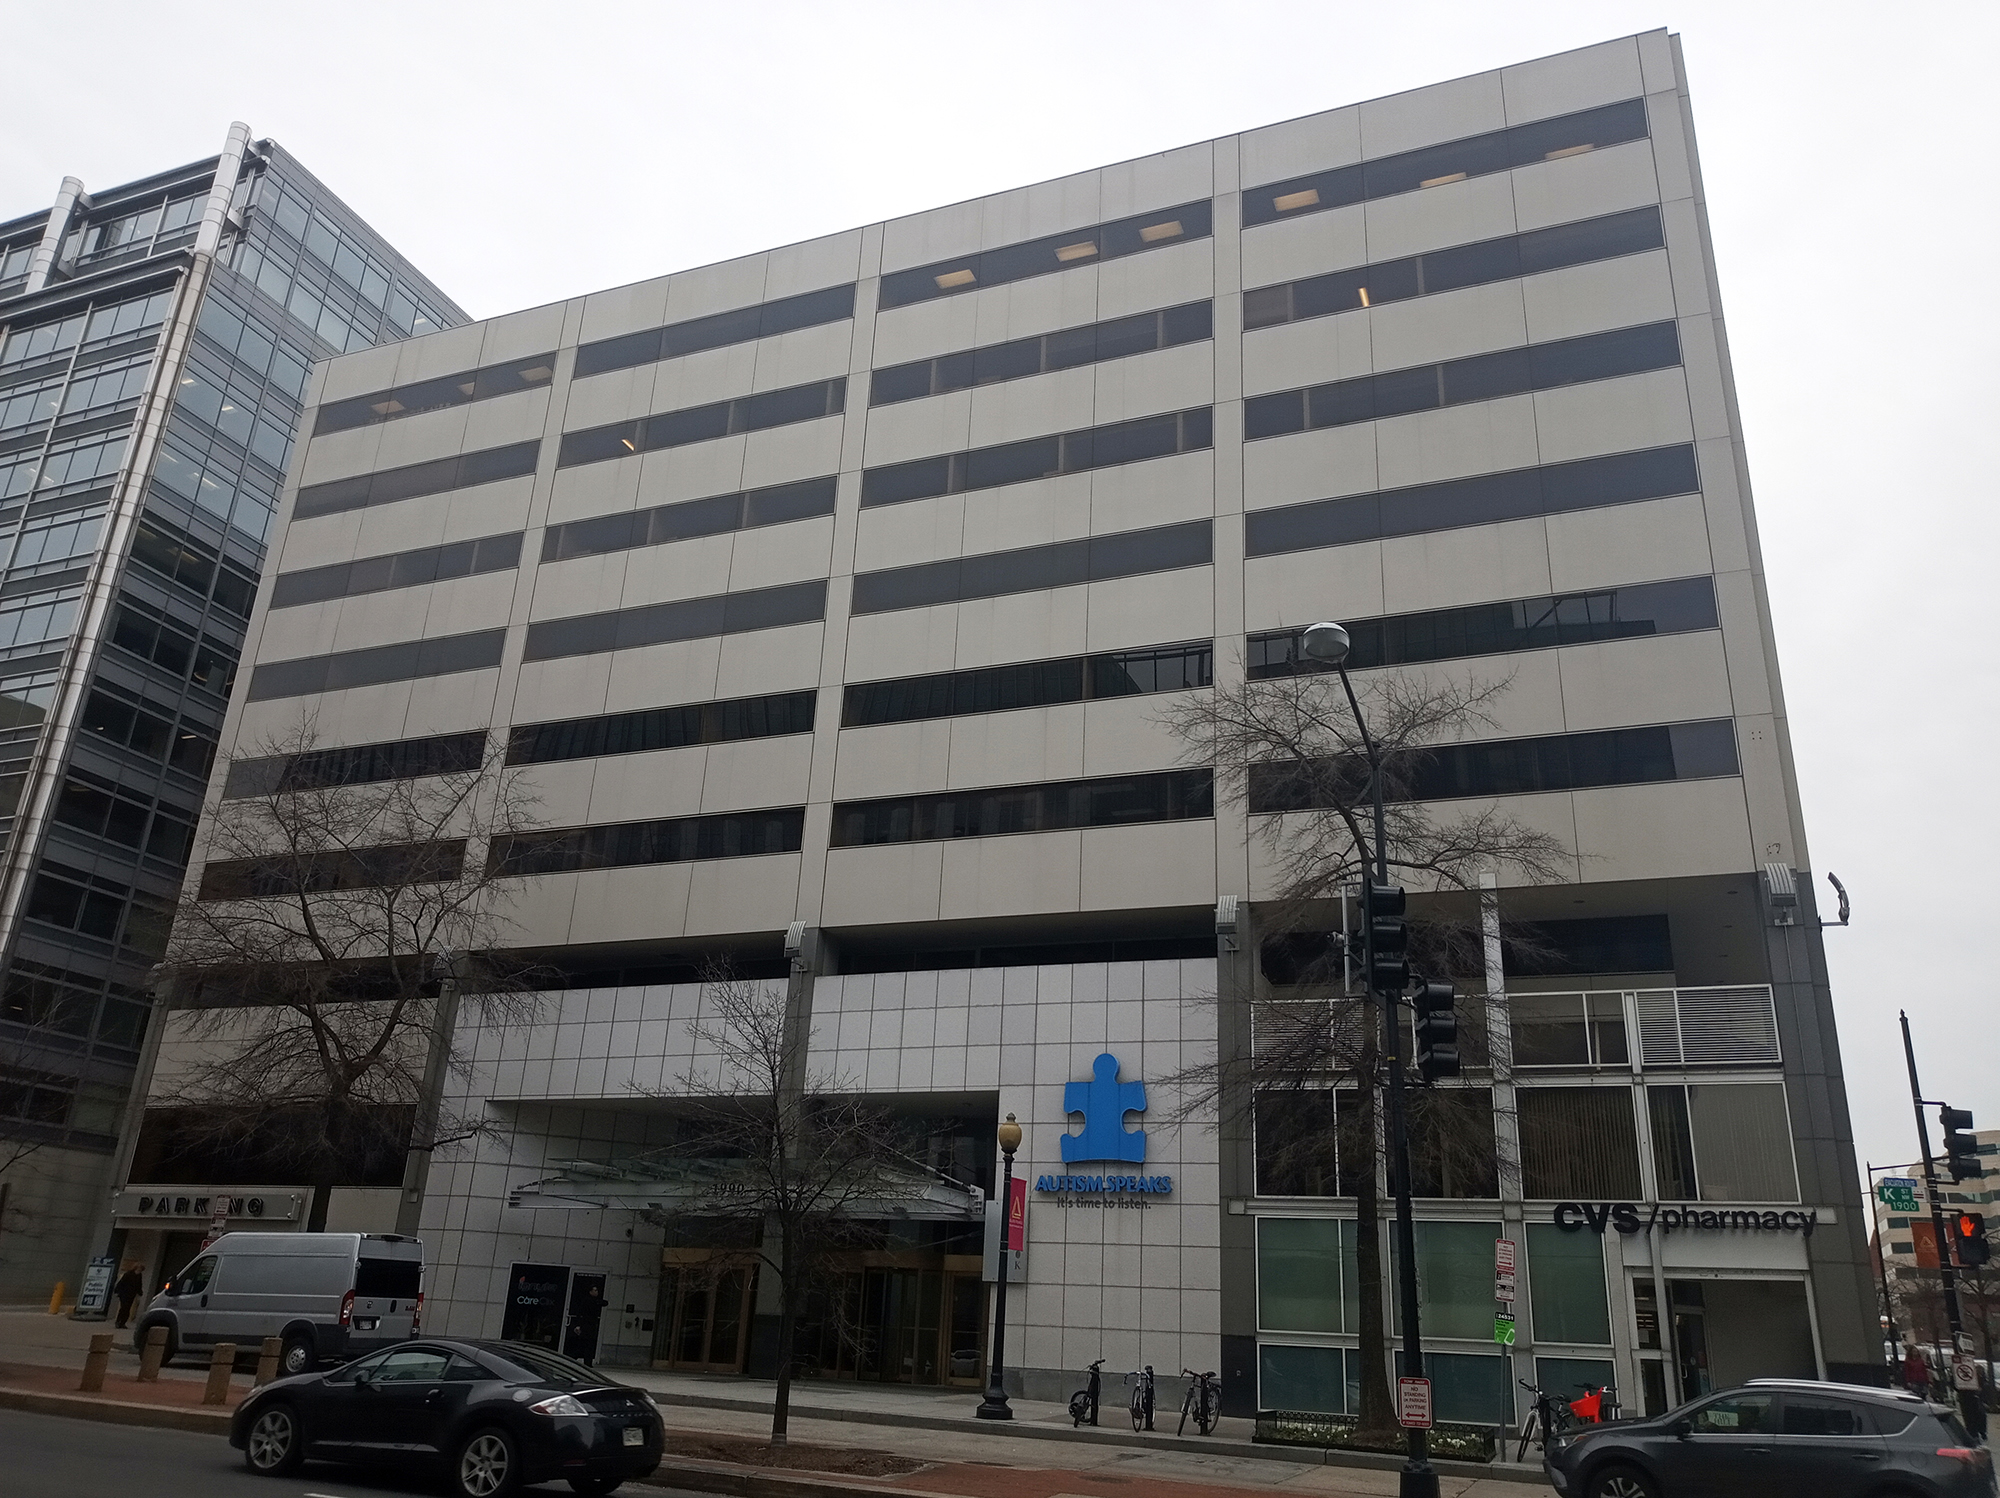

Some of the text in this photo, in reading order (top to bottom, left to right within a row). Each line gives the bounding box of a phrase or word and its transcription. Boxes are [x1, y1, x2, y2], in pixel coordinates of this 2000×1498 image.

[1035, 1175, 1173, 1193] AUTISM SPEAKS
[1884, 1188, 1896, 1200] K
[138, 1197, 263, 1215] PARKNG
[1057, 1197, 1151, 1210] It's time to listen.
[1892, 1202, 1917, 1210] 1900
